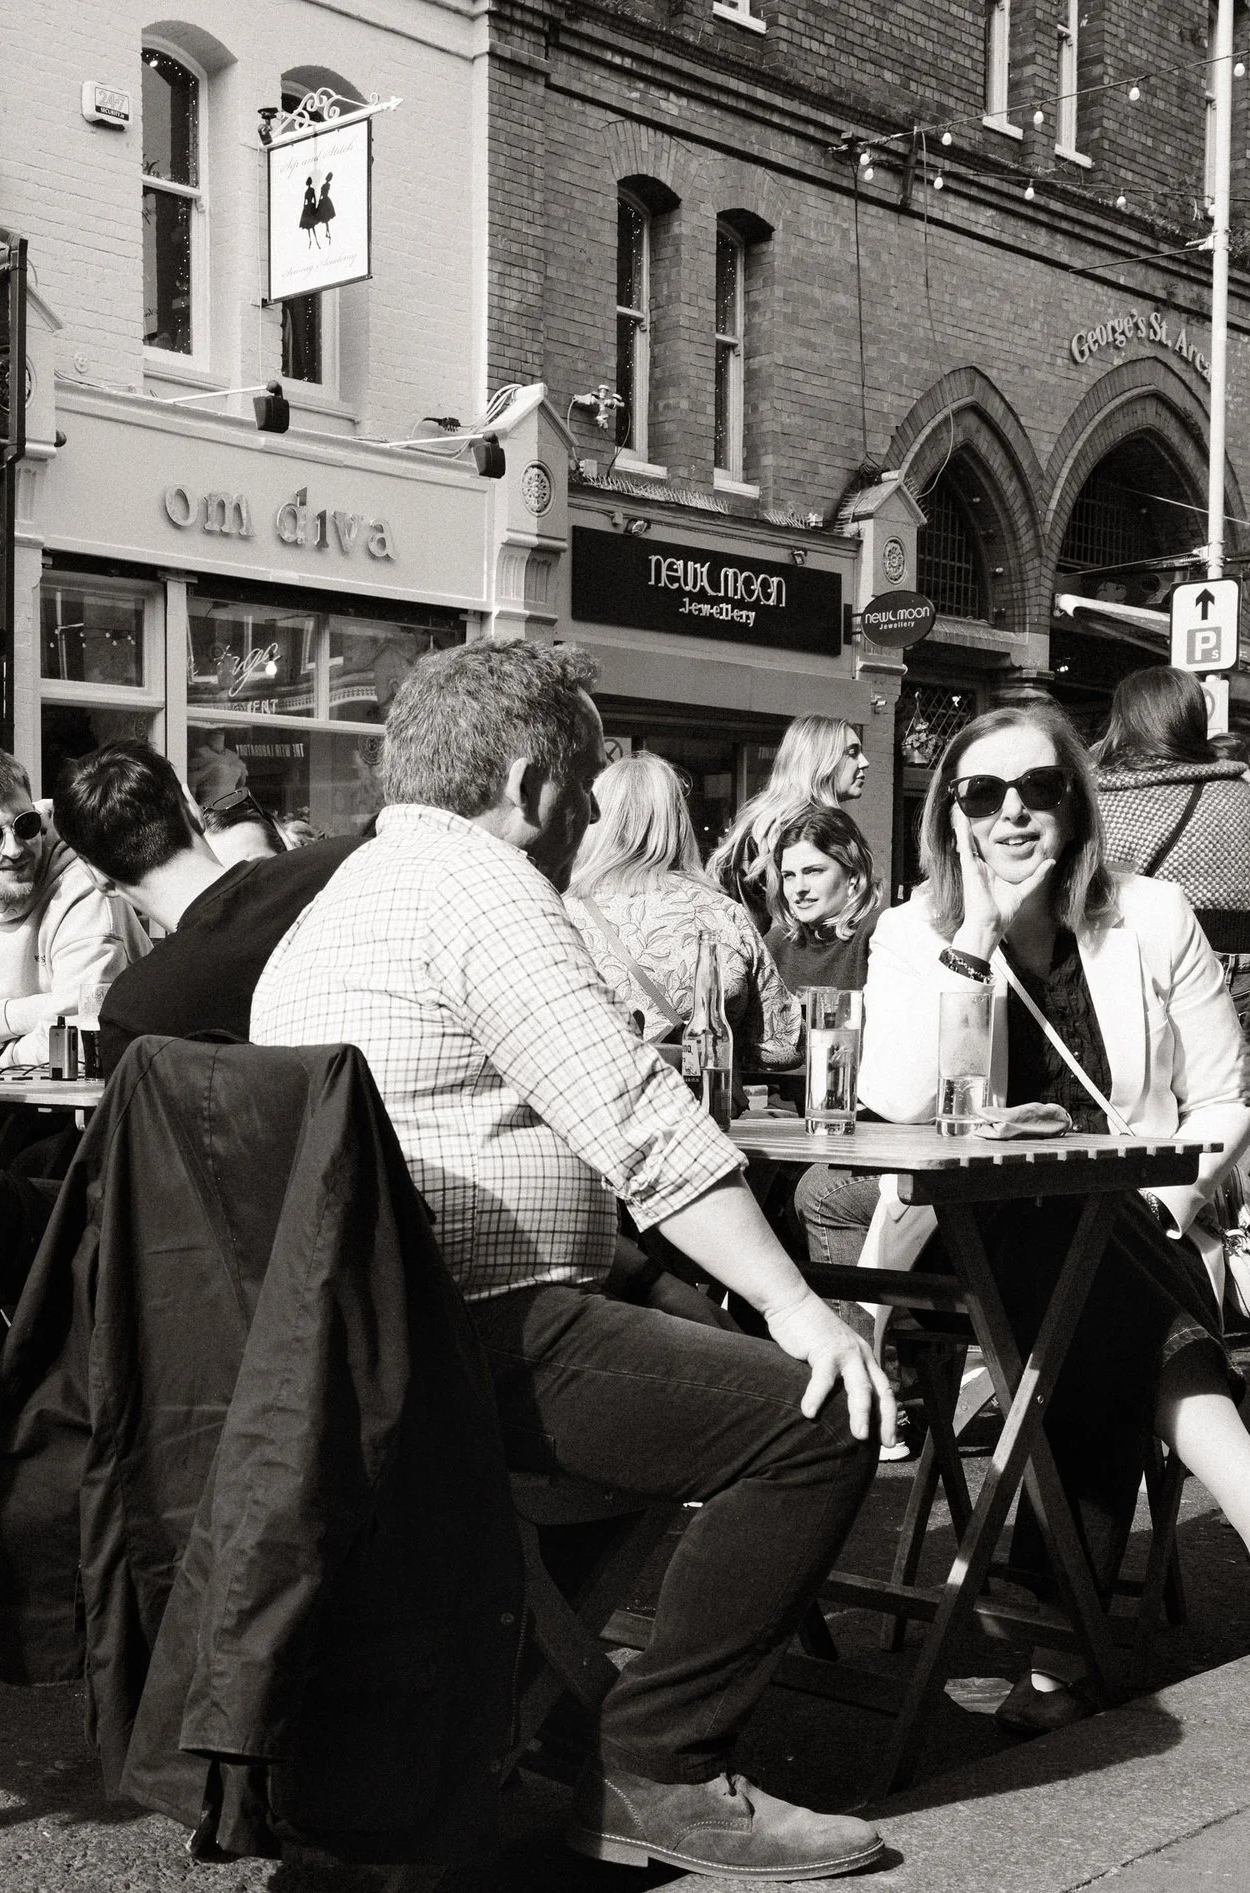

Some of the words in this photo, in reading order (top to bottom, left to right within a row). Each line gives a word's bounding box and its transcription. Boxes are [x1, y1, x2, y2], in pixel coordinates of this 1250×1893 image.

[1071, 308, 1147, 363] George's
[1149, 311, 1172, 348] St.
[164, 482, 255, 538] om
[276, 486, 399, 560] diva
[679, 597, 756, 627] Jewellery
[879, 620, 916, 631] Jewellery
